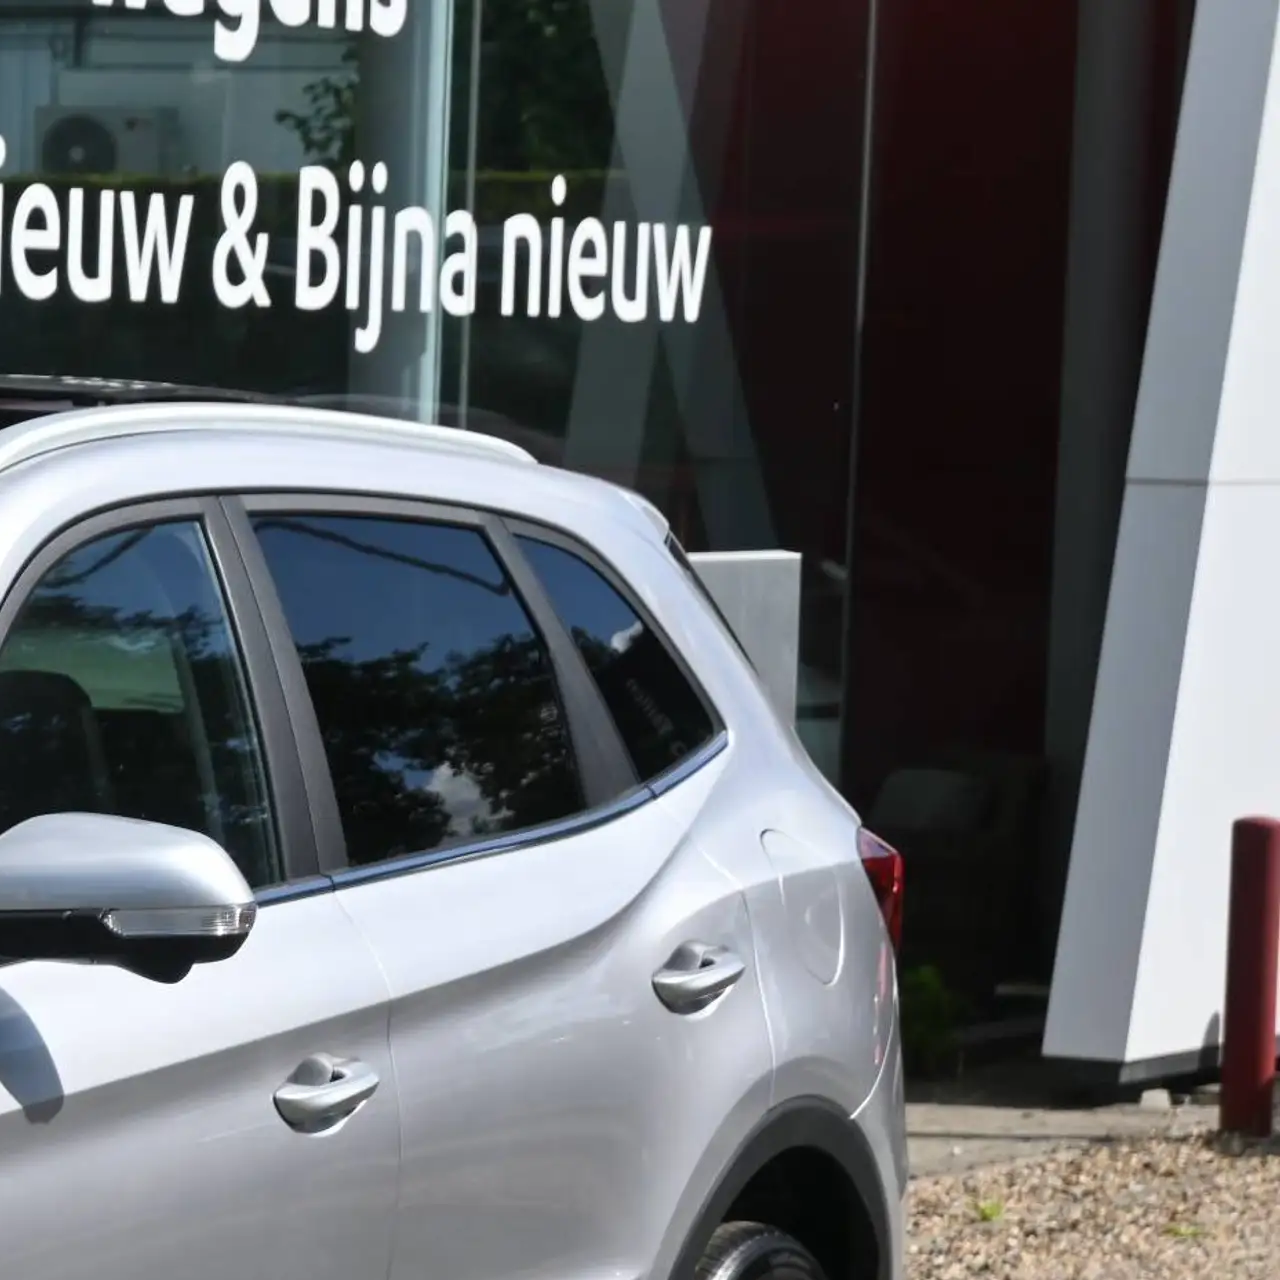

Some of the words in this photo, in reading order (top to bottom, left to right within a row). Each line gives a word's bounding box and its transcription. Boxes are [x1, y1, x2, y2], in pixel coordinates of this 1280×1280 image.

[212, 160, 271, 308] &
[295, 160, 477, 353] Bijna
[500, 174, 712, 322] nieuw
